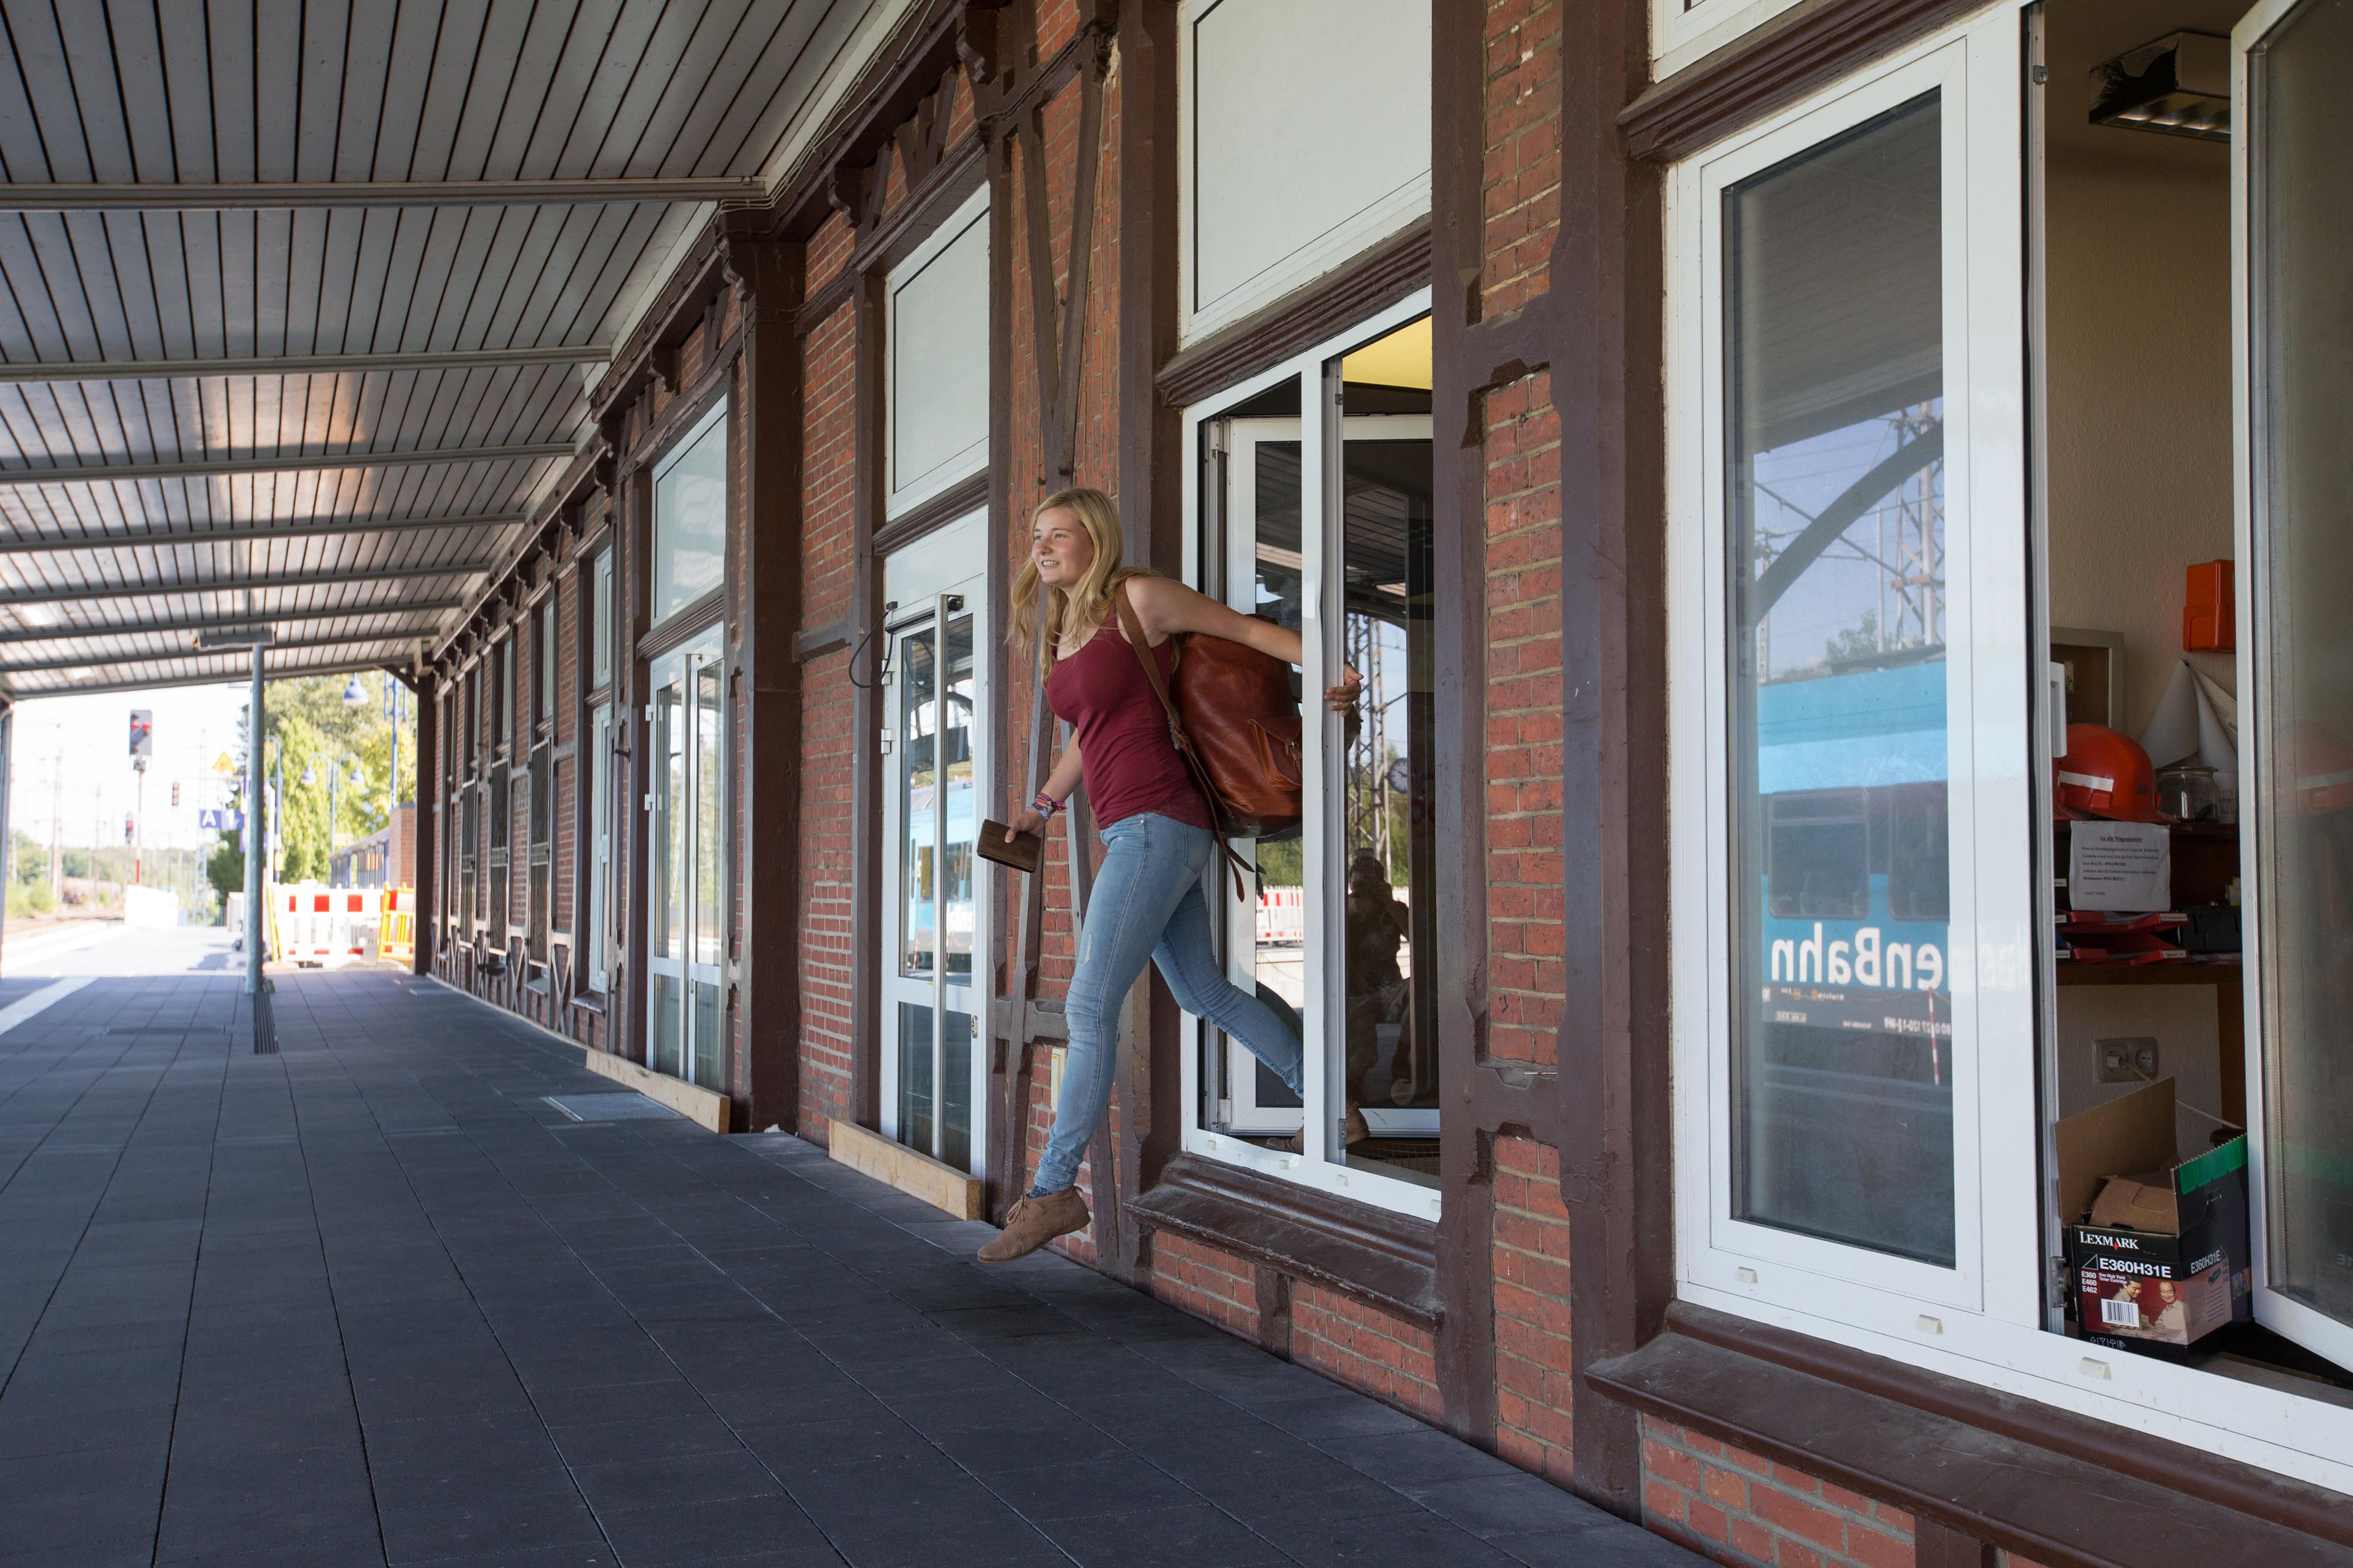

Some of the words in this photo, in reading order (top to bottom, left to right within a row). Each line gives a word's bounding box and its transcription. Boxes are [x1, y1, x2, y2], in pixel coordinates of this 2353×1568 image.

[202, 809, 216, 826] A
[2080, 1231, 2139, 1250] LEXMARK
[2099, 1257, 2172, 1279] E360H31E
[2191, 1249, 2221, 1275] E360H31E
[2081, 1271, 2097, 1279] E360
[2082, 1278, 2097, 1286] E460
